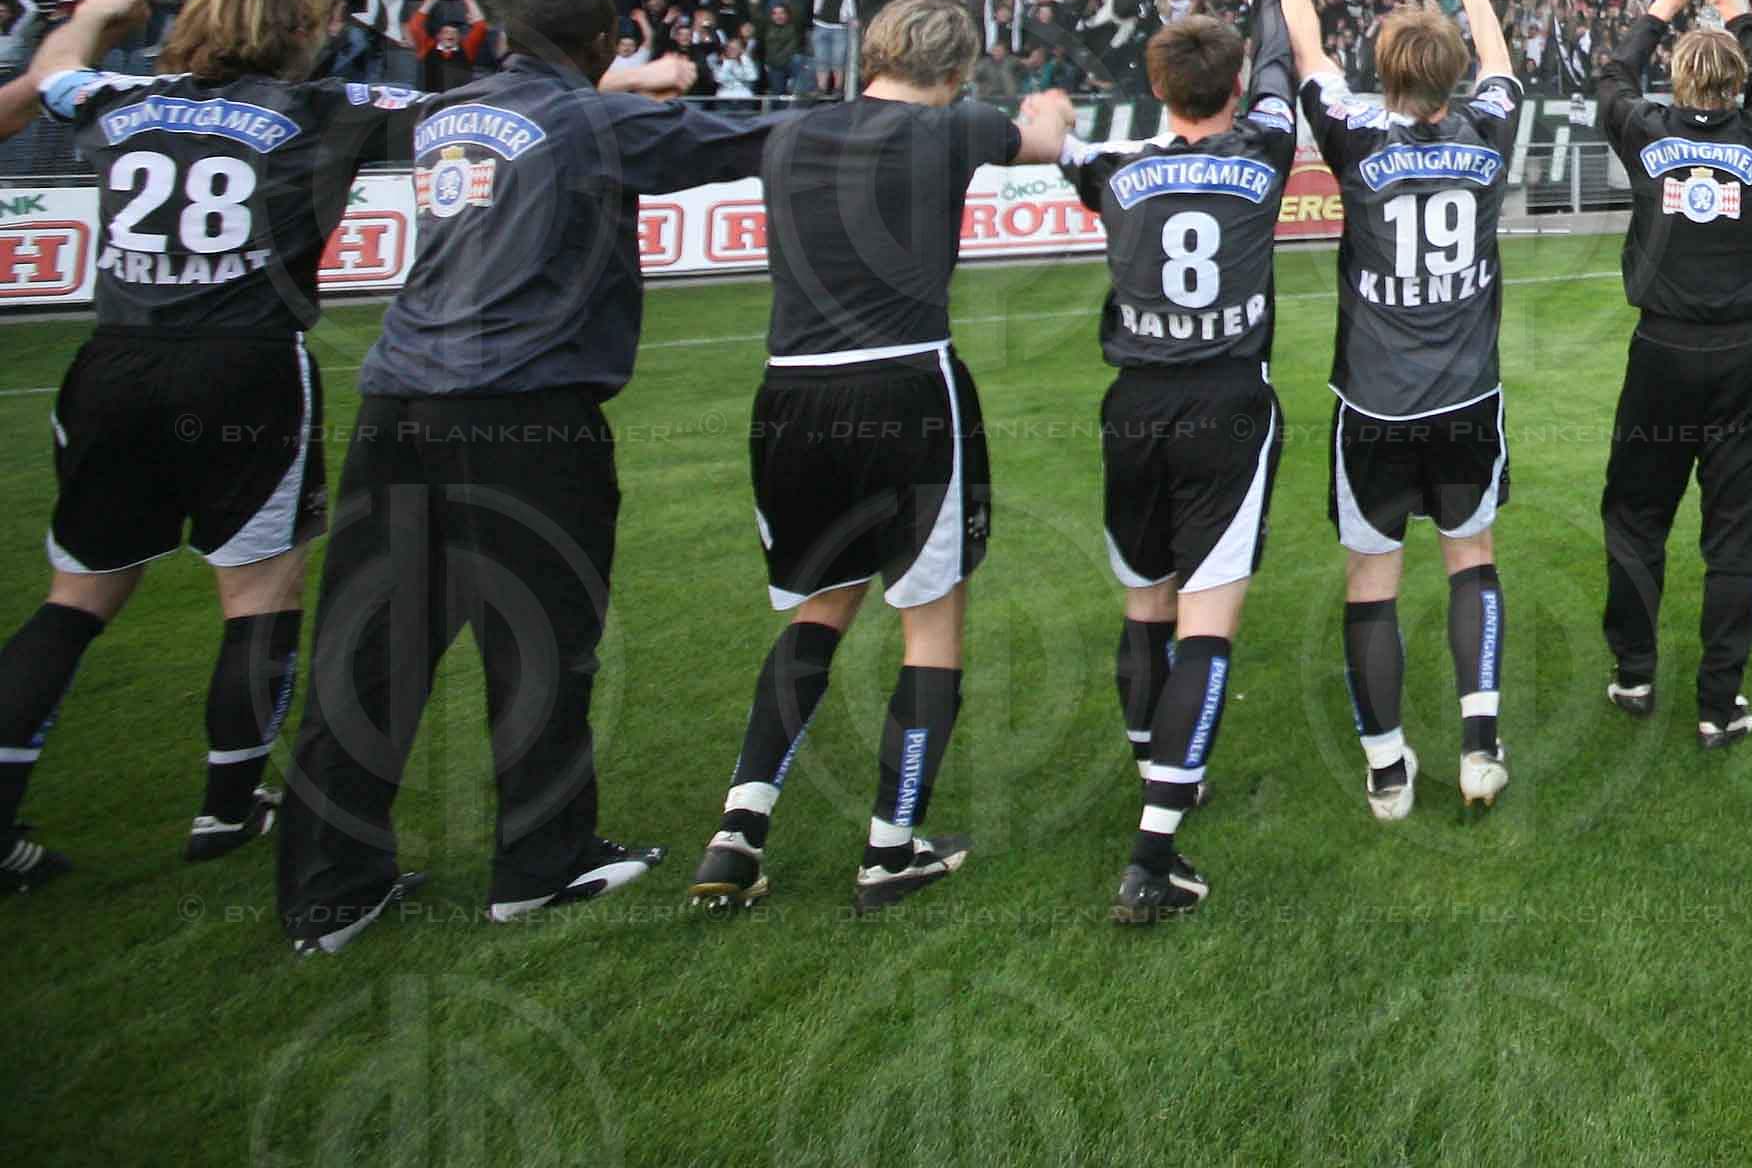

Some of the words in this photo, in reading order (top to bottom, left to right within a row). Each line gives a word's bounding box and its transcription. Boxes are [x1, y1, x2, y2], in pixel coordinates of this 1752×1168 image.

[414, 111, 533, 148] UNTIGAMER
[1116, 161, 1270, 200] PUNTIGAMER
[1366, 150, 1497, 182] PUNTIGAMER
[108, 150, 257, 254] 28
[1383, 189, 1478, 279] 19
[1161, 210, 1221, 309] 8
[1359, 258, 1492, 307] KIENZL
